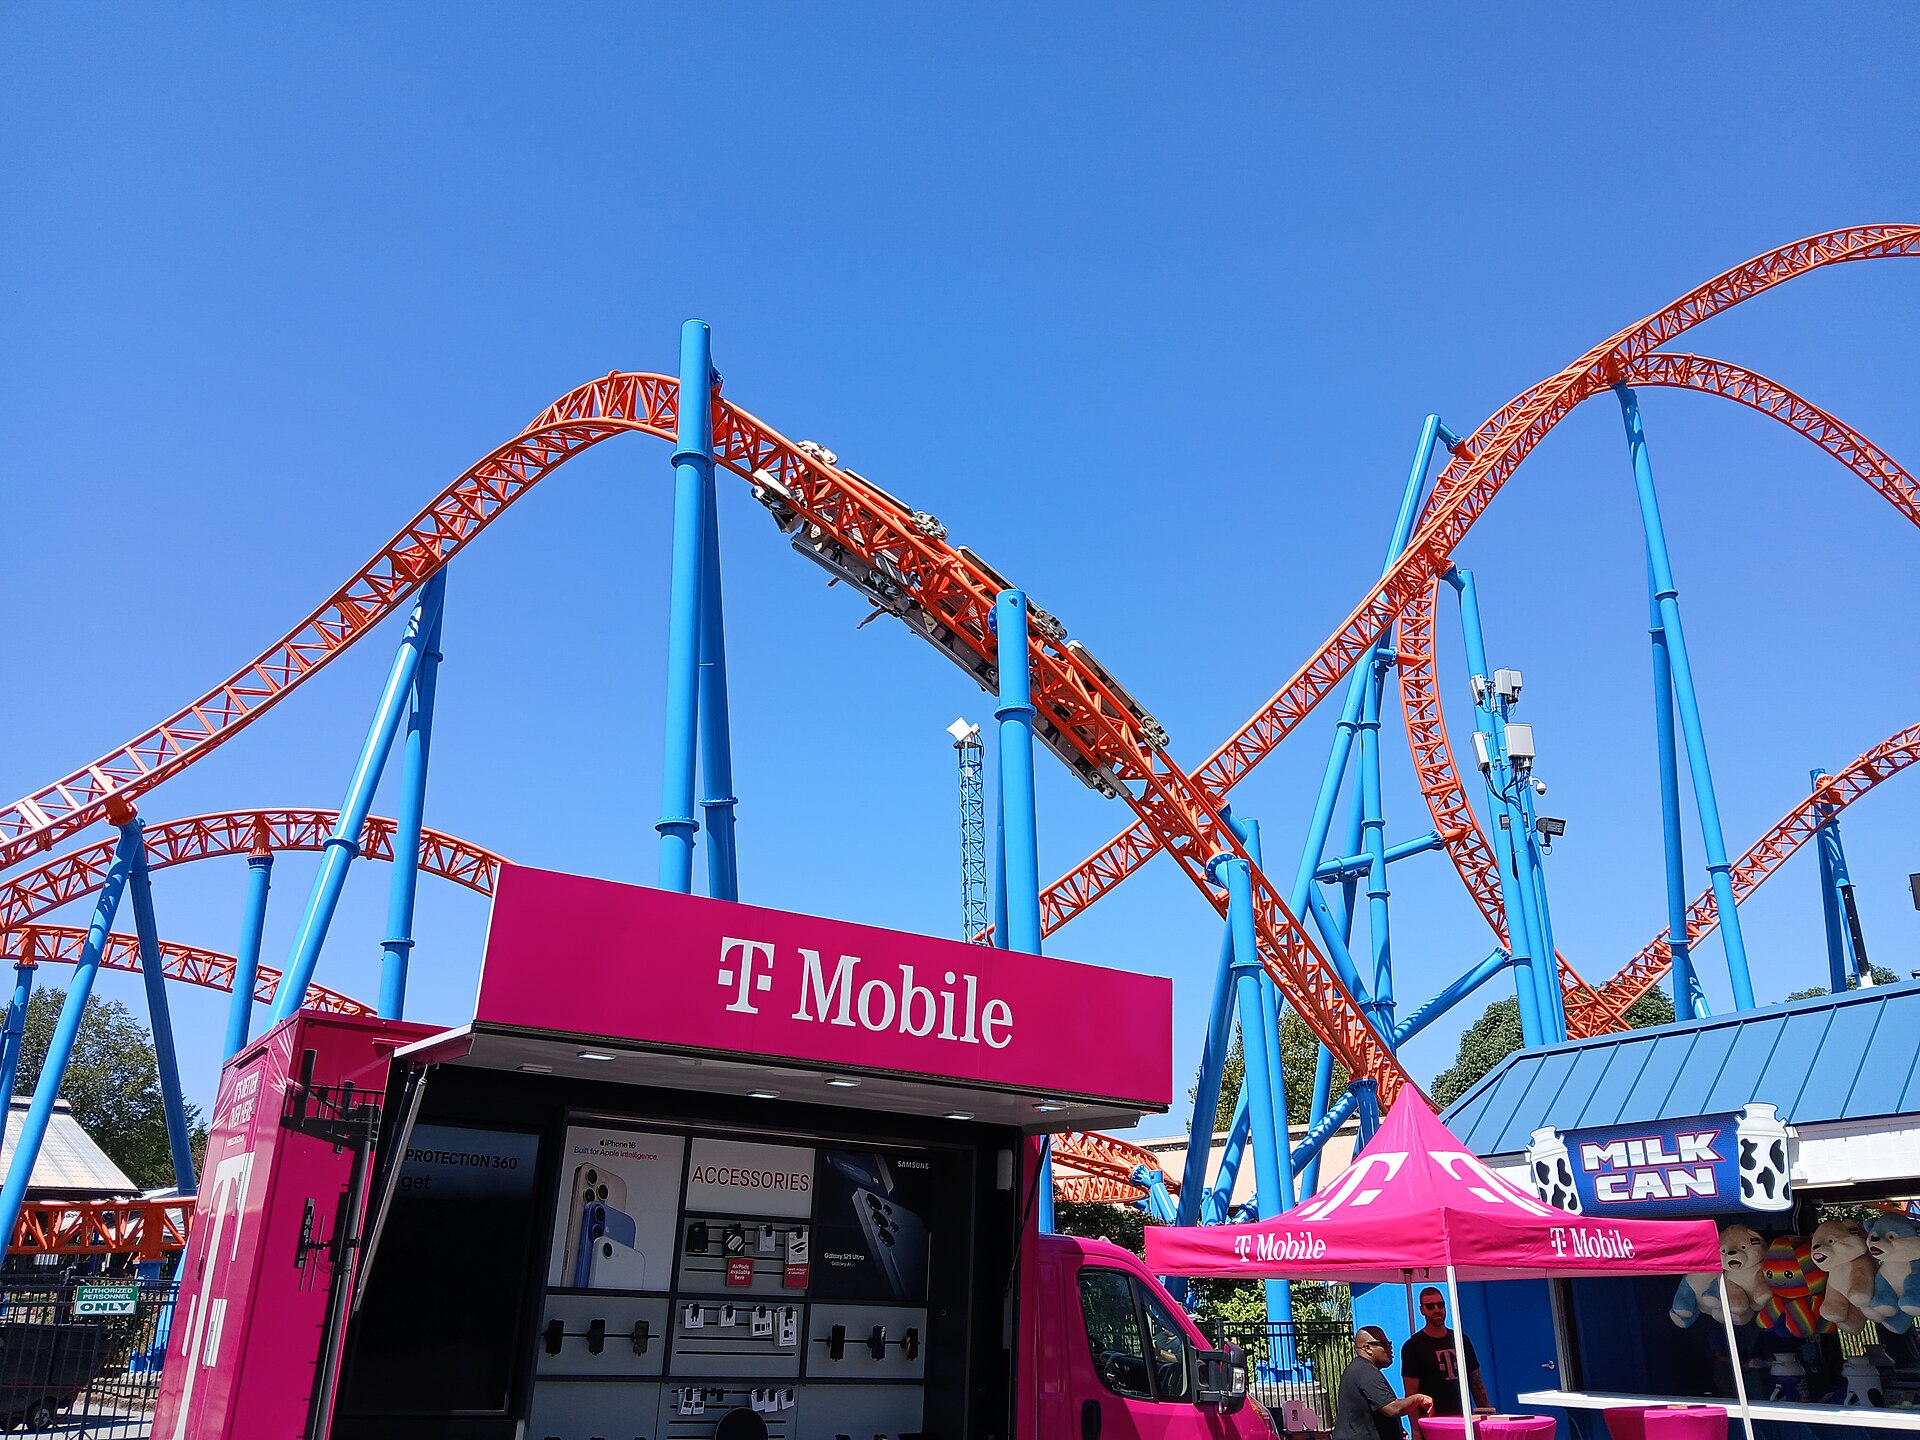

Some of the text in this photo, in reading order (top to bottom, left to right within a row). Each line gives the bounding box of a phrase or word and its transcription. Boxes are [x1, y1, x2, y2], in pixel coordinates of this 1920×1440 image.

[717, 936, 1013, 1048] T Mobile
[574, 1146, 589, 1155] Built
[600, 1149, 620, 1157] Apple
[605, 1139, 636, 1149] iPhone 16
[1580, 1130, 1726, 1172] MILK
[405, 1149, 491, 1168] PROTECTION
[897, 1161, 930, 1170] SAMSUNG
[401, 1174, 432, 1192] get
[691, 1165, 810, 1192] ACCESSORIES
[1594, 1165, 1719, 1204] CAN
[1234, 1231, 1327, 1263] T Mobile
[1550, 1228, 1636, 1259] T Mobile
[824, 1252, 843, 1261] Galaxy
[80, 1302, 131, 1312] ONLY
